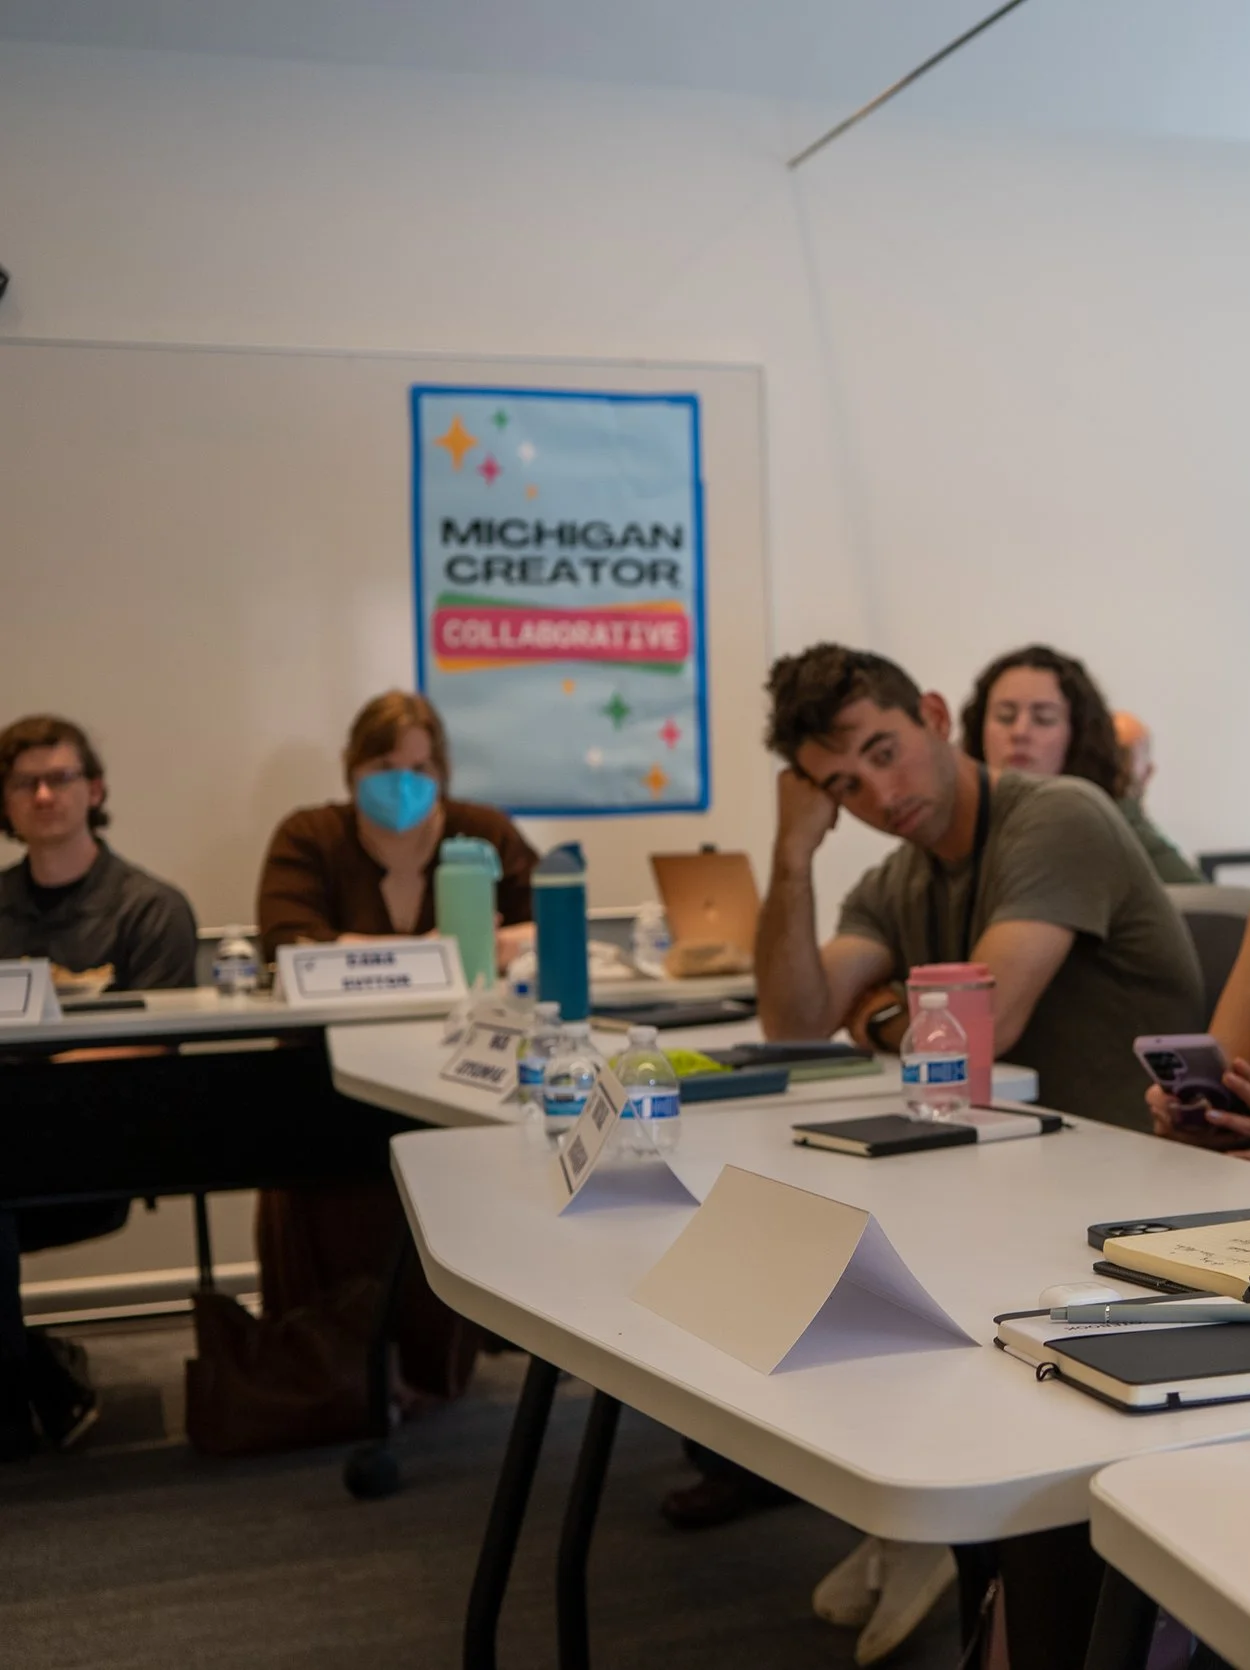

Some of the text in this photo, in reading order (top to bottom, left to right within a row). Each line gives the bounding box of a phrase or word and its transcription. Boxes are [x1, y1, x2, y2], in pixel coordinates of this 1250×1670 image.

[440, 517, 684, 551] MICHIGAN
[444, 555, 682, 589] CREATOR
[442, 618, 682, 652] COLLABORATIVE
